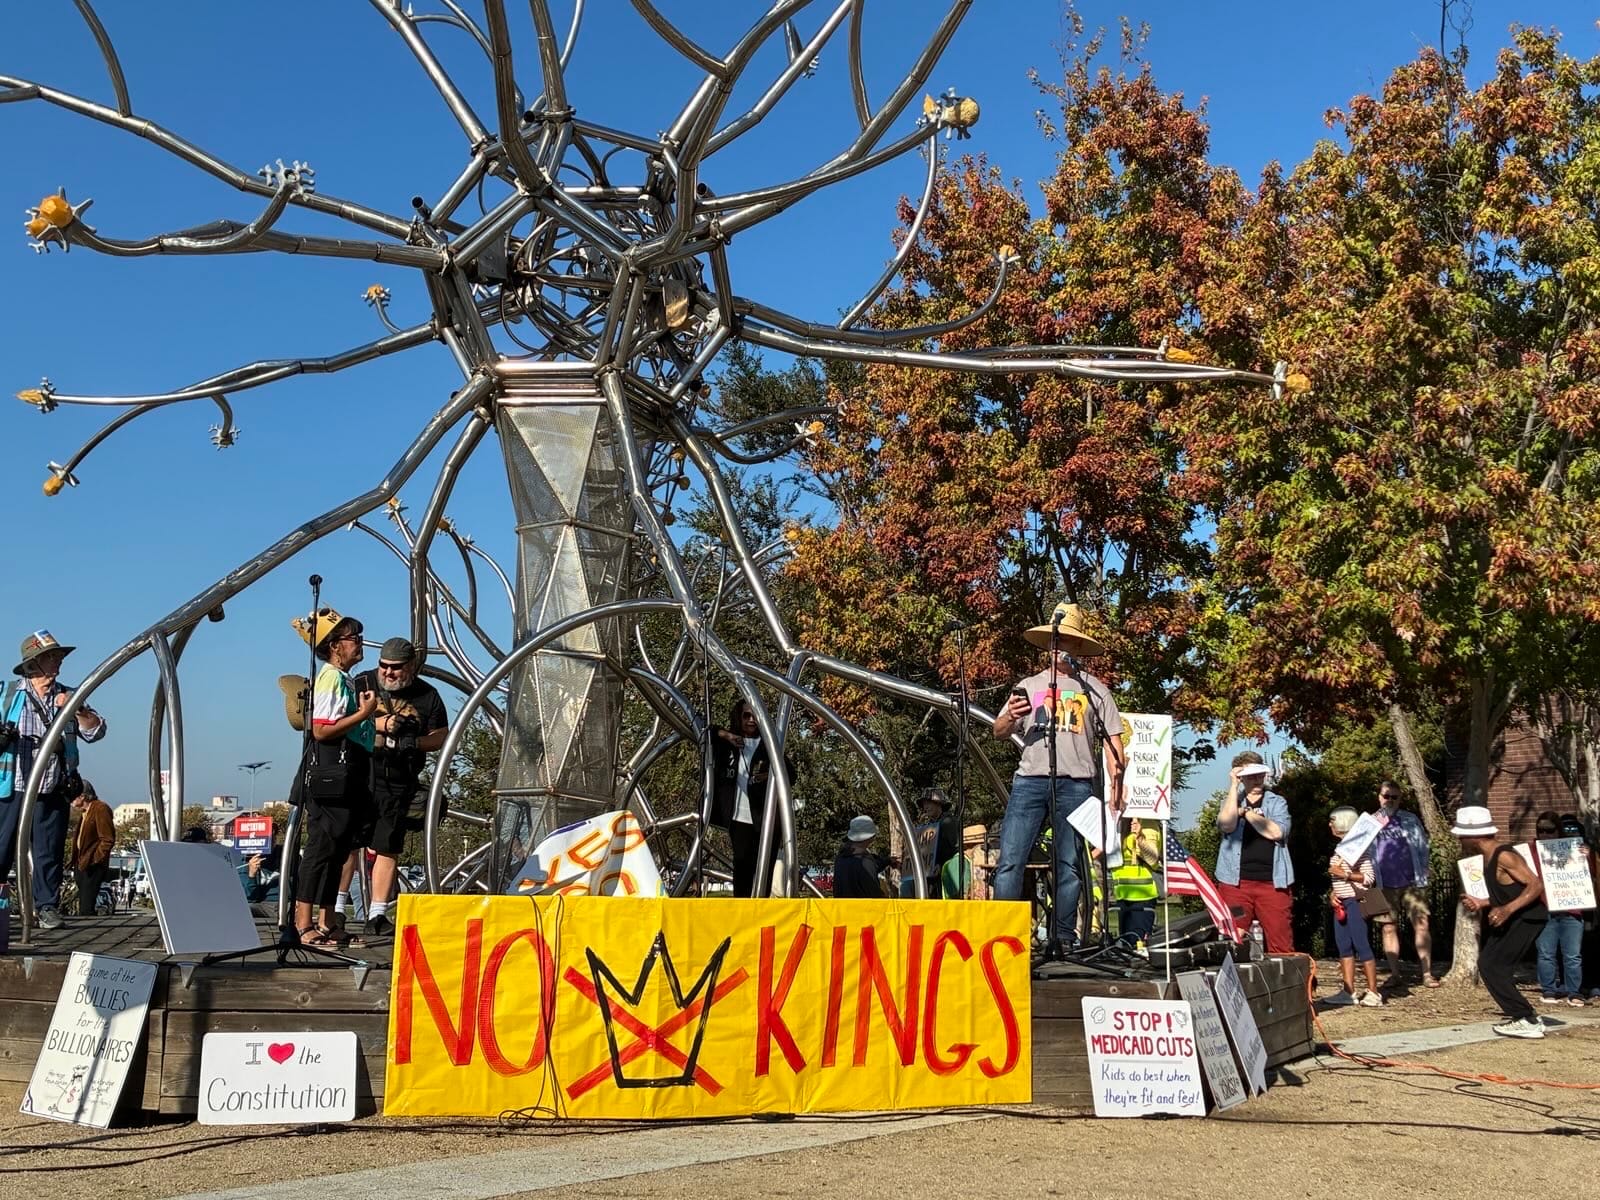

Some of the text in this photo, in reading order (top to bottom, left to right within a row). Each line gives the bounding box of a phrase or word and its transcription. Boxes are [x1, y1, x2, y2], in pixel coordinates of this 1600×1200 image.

[1133, 720, 1155, 731] KING
[1133, 752, 1159, 762] BURGER
[1136, 766, 1156, 776] KING
[1133, 786, 1152, 796] KING
[1129, 798, 1156, 806] AMERICA
[518, 811, 646, 893] YES
[1546, 870, 1589, 882] STRONGER
[1552, 890, 1579, 898] PEOPLE
[1557, 898, 1584, 907] POWER
[77, 960, 136, 984] Regime of the
[74, 983, 130, 1011] BULLIES
[395, 918, 1025, 1079] NO KINGS
[76, 1011, 110, 1030] for the
[1113, 1010, 1173, 1033] STOP!
[47, 1029, 134, 1063] BILLIONAIRES
[245, 1042, 321, 1065] I the
[1091, 1034, 1154, 1055] MEDICAID
[1156, 1037, 1194, 1057] CUTS
[1101, 1063, 1191, 1082] Kids do best when
[207, 1077, 347, 1112] Constitution
[1104, 1087, 1200, 1107] they're fit and fed!
